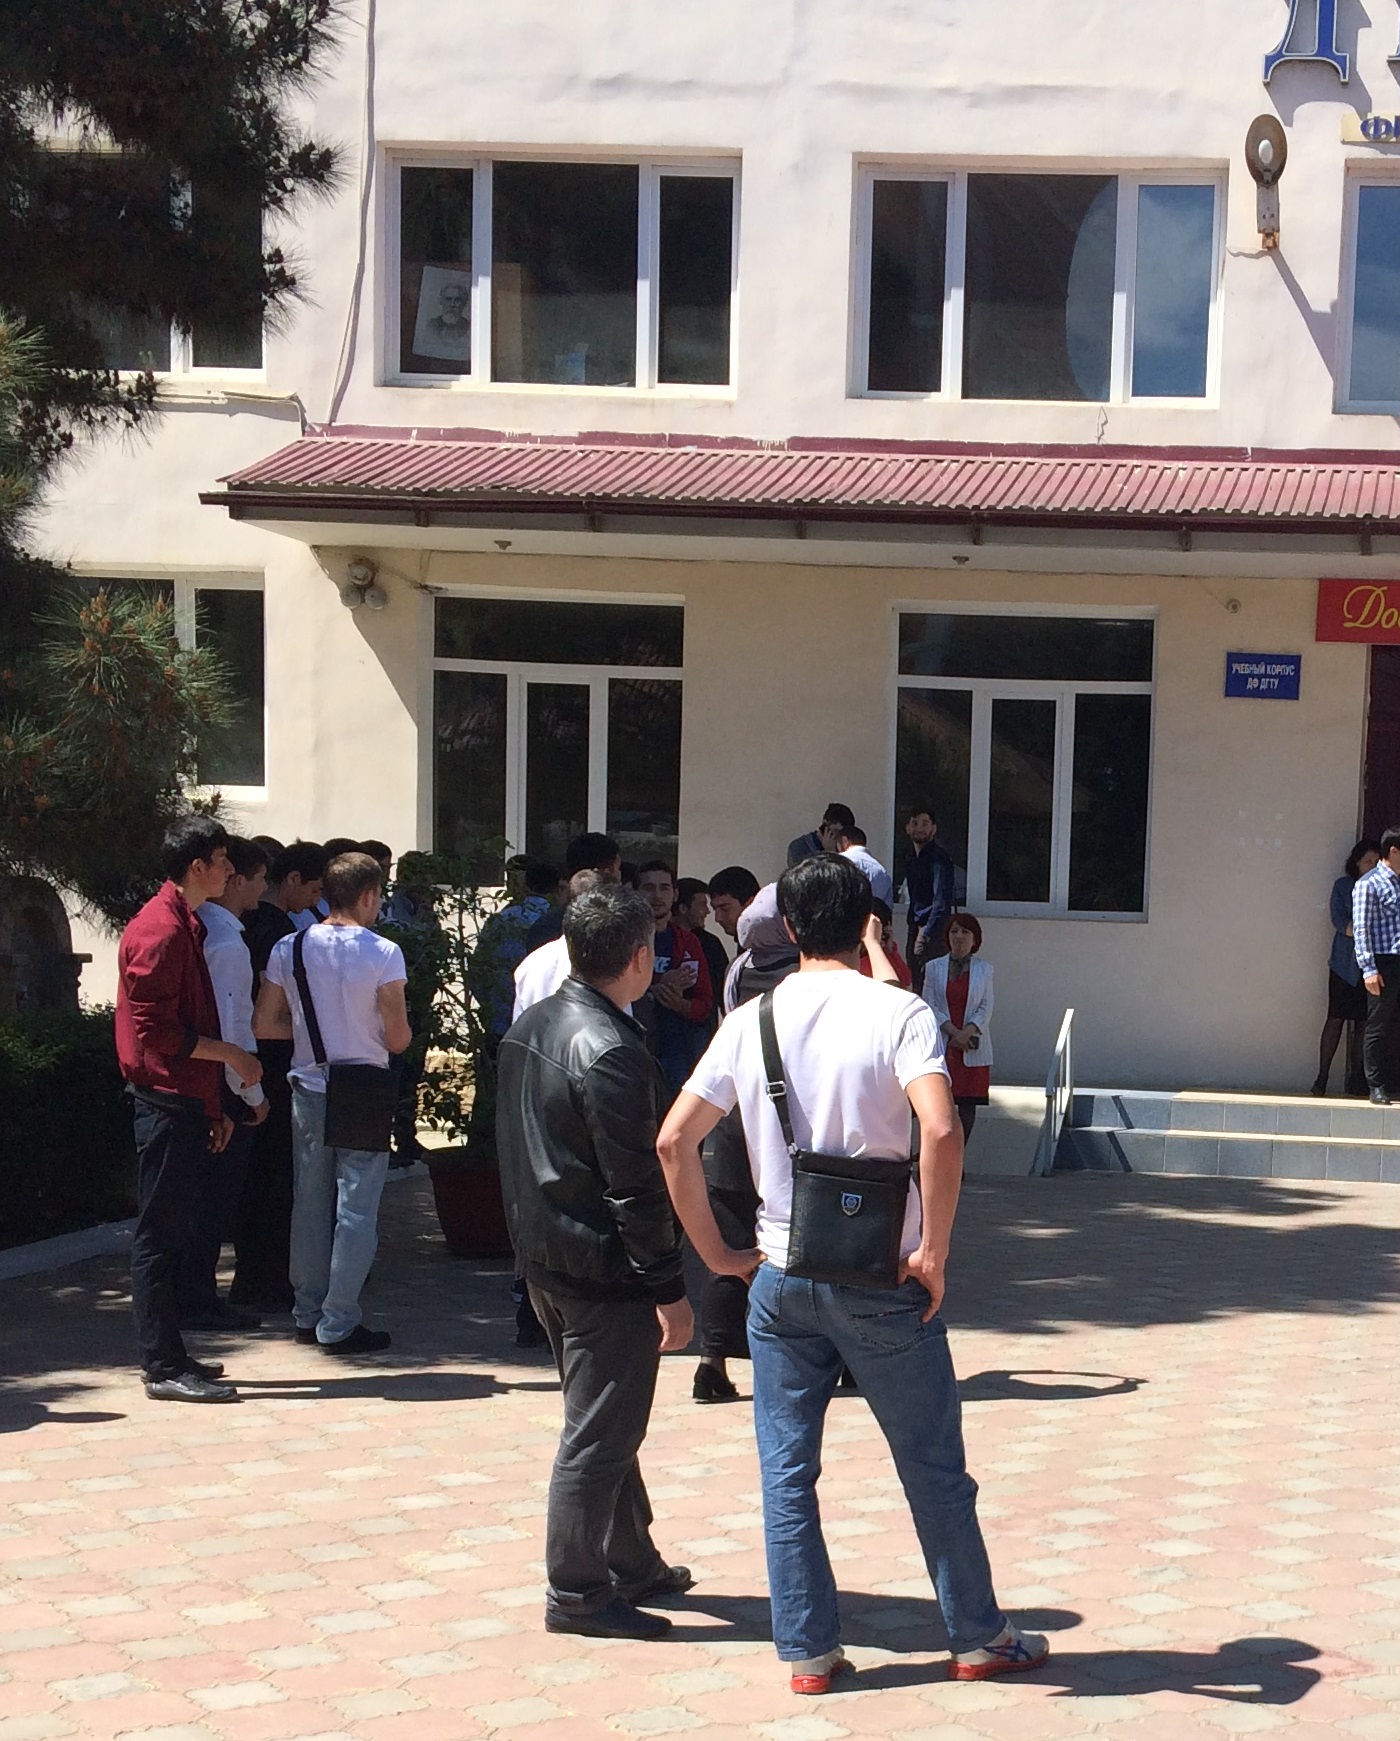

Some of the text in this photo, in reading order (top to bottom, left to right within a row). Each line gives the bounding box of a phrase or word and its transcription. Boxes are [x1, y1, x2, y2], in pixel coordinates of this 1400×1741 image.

[1231, 661, 1295, 676] УЧЕБНЫЙ КОРПУС
[1259, 678, 1279, 690] ДГТУ
